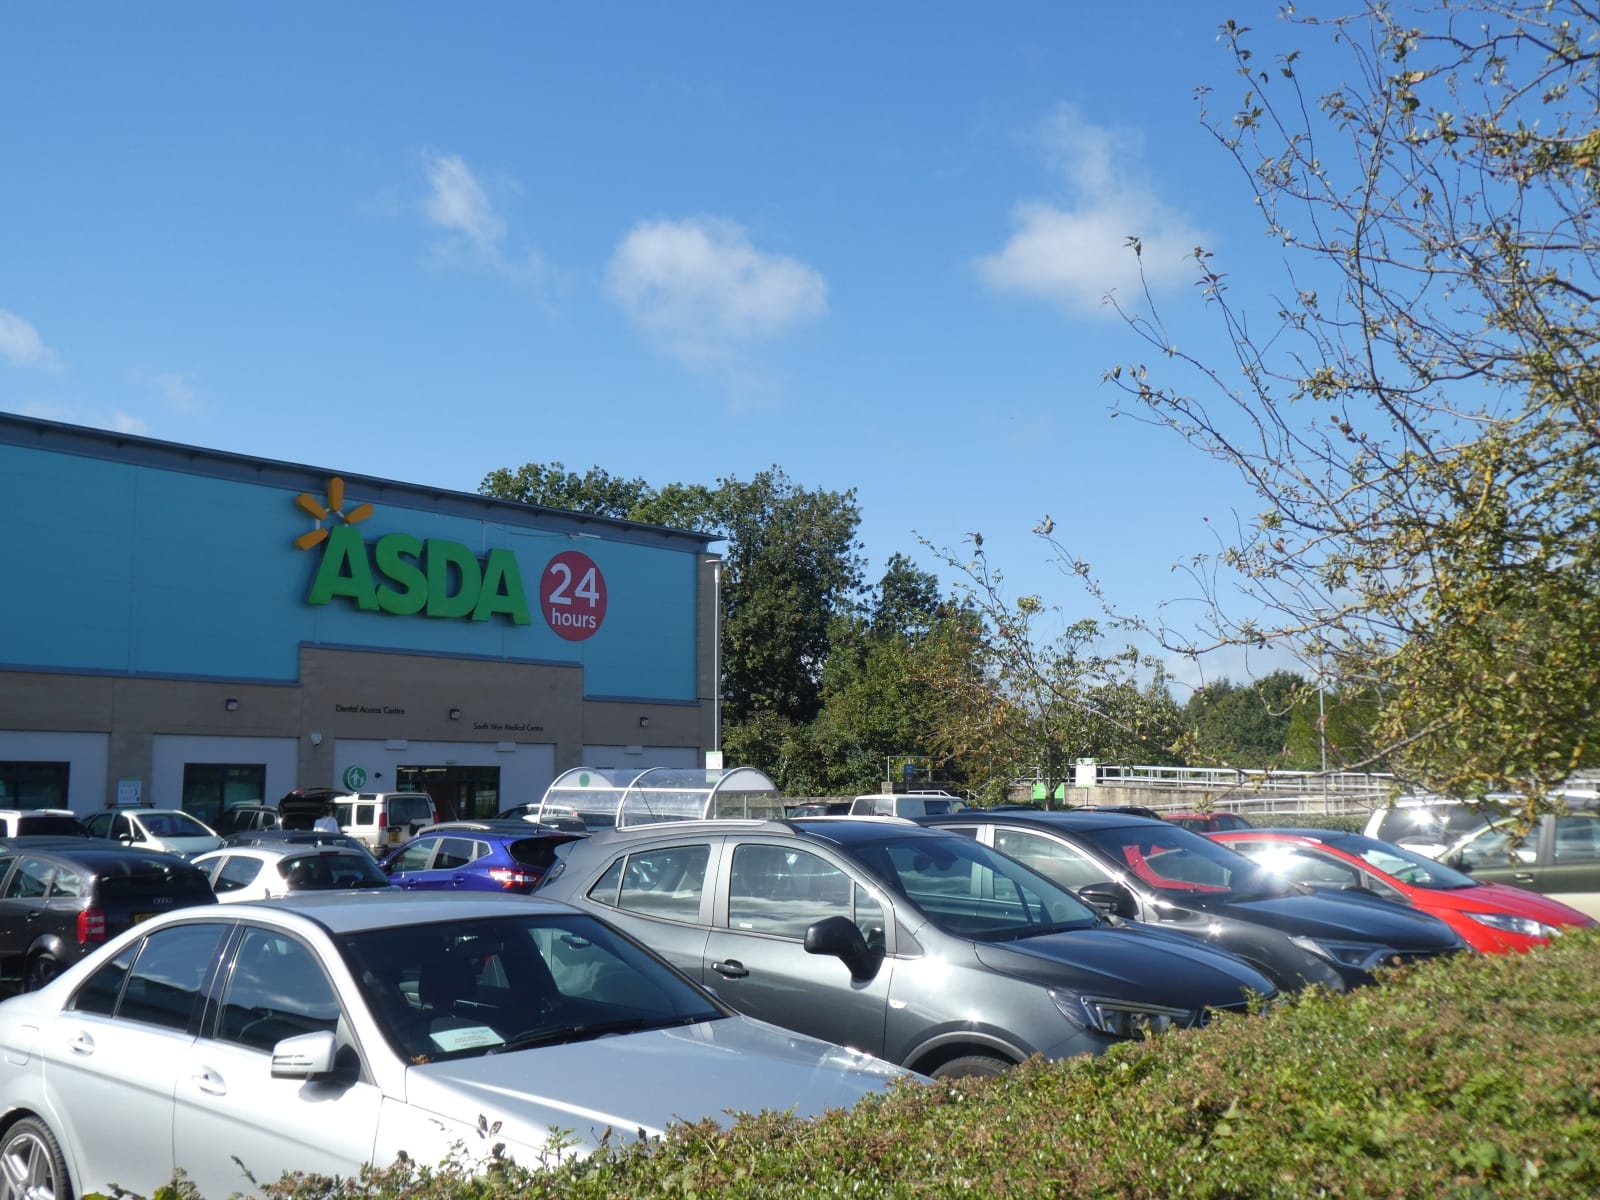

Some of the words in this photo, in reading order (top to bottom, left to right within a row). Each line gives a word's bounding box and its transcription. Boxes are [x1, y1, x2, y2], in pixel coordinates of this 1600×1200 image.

[307, 525, 531, 626] ASDA
[549, 562, 600, 608] 24
[551, 607, 596, 629] hours
[335, 703, 359, 713] Dental
[383, 705, 405, 715] Centre
